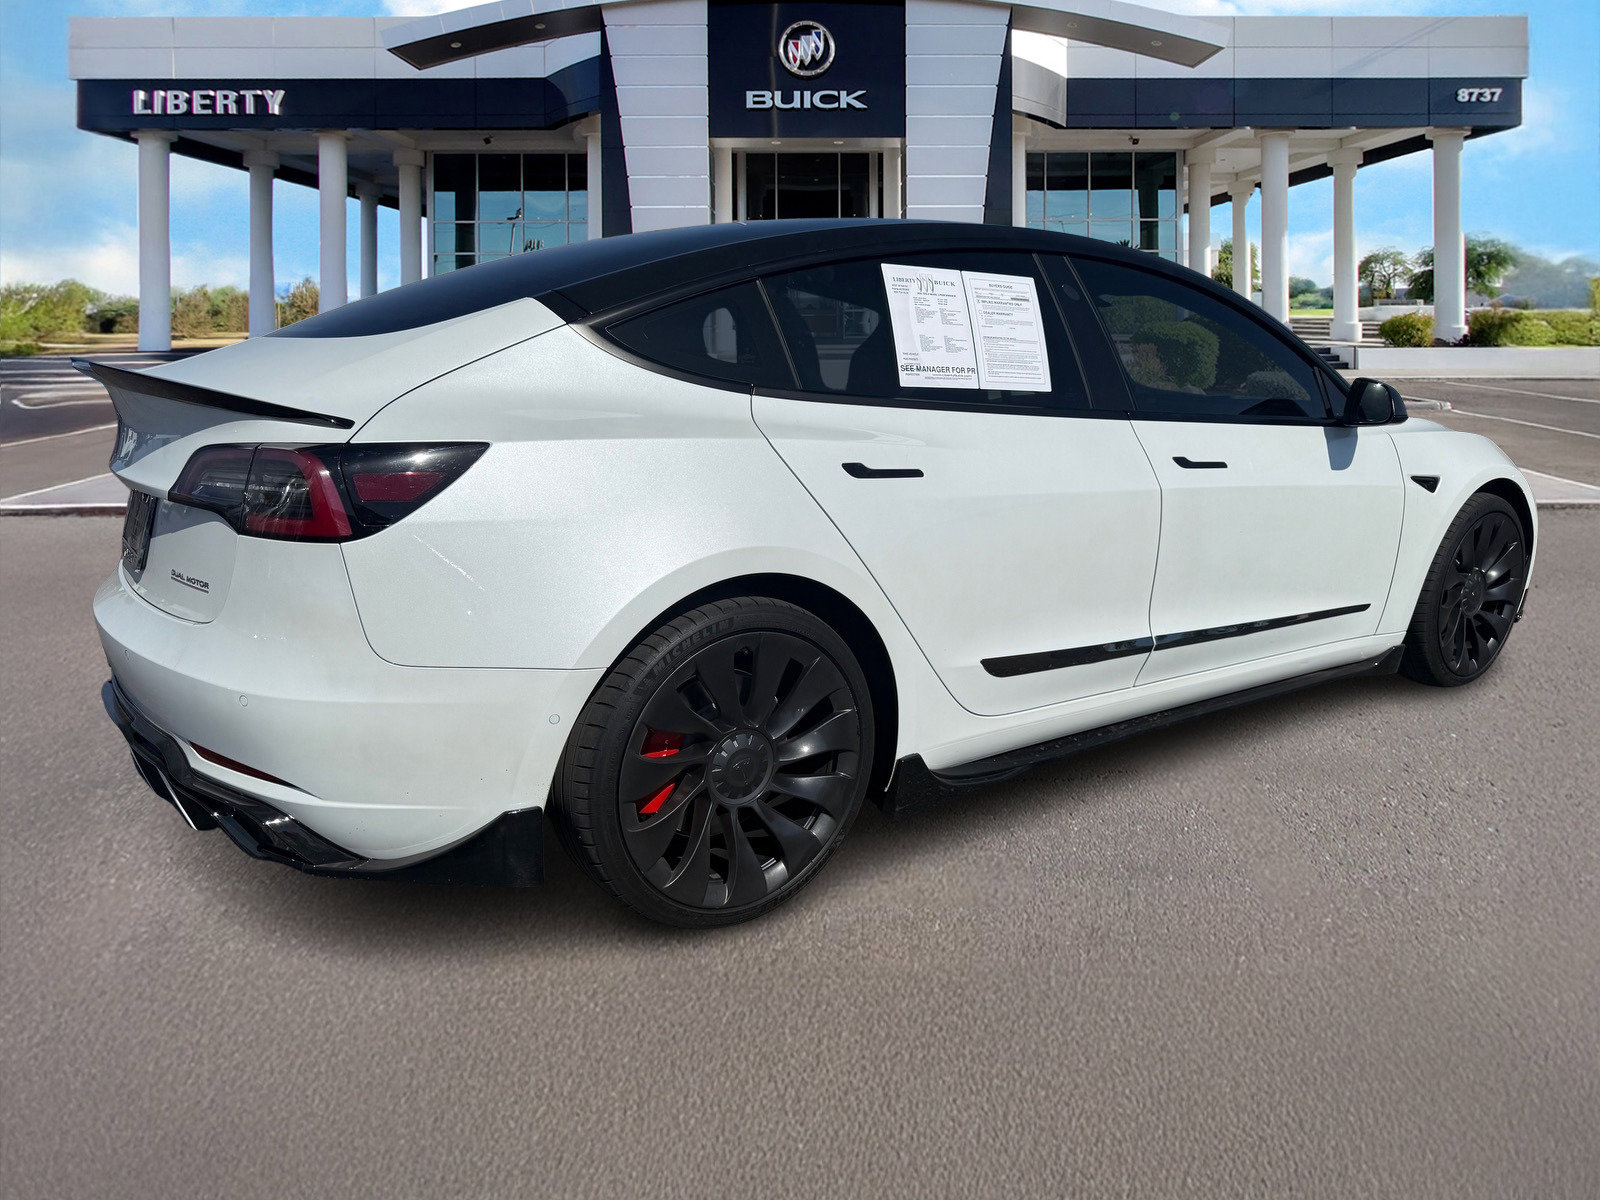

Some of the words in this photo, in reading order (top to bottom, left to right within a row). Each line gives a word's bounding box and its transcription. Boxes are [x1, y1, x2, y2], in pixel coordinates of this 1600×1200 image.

[132, 89, 286, 115] LIBERTY
[745, 90, 868, 109] BUICK
[1456, 88, 1503, 102] 8737
[892, 276, 916, 284] LIBERTY
[900, 364, 915, 372] SEE
[915, 365, 951, 374] MANAGER
[951, 366, 966, 374] FOR
[967, 367, 976, 375] PR
[171, 569, 185, 581] DUAL
[186, 576, 209, 589] MOTOR
[653, 618, 732, 675] MICHELIN
